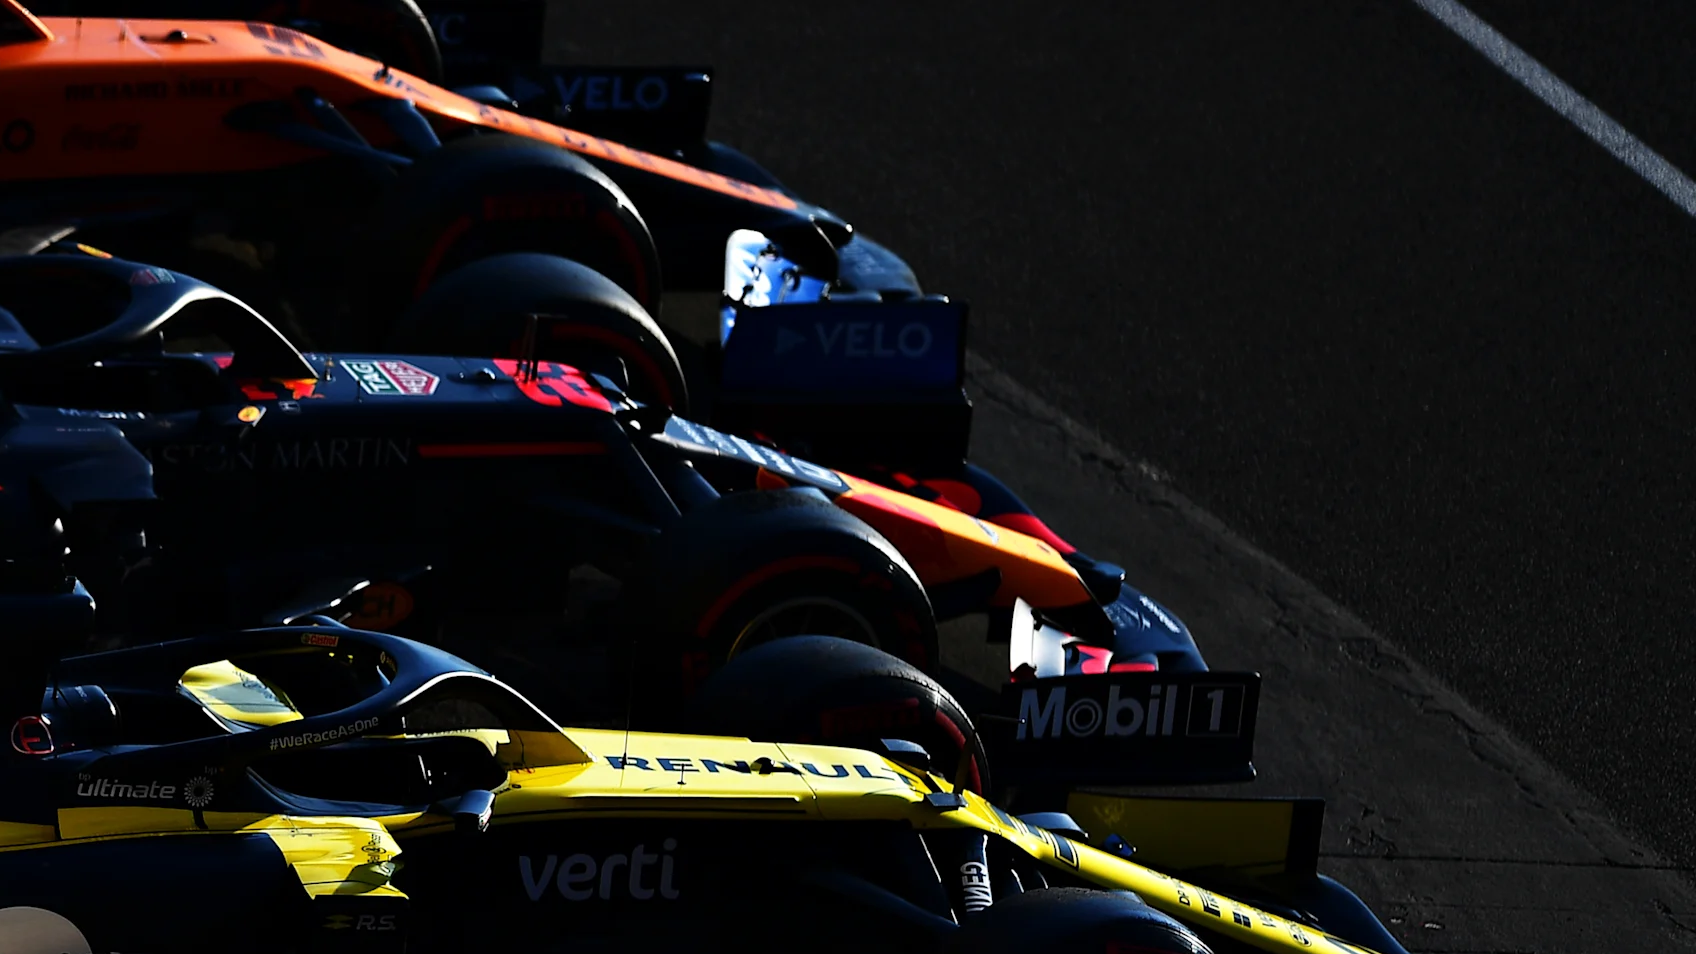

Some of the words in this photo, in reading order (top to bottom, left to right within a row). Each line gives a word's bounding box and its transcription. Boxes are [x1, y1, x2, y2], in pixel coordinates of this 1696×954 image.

[555, 75, 668, 110] VELO
[816, 322, 932, 358] VELO
[273, 437, 414, 470] MARTIN
[1016, 684, 1178, 741] Mobil
[1206, 687, 1225, 734] 1
[269, 715, 379, 752] #WeRaceAsOne
[77, 779, 176, 799] ultimate
[519, 837, 681, 903] verti
